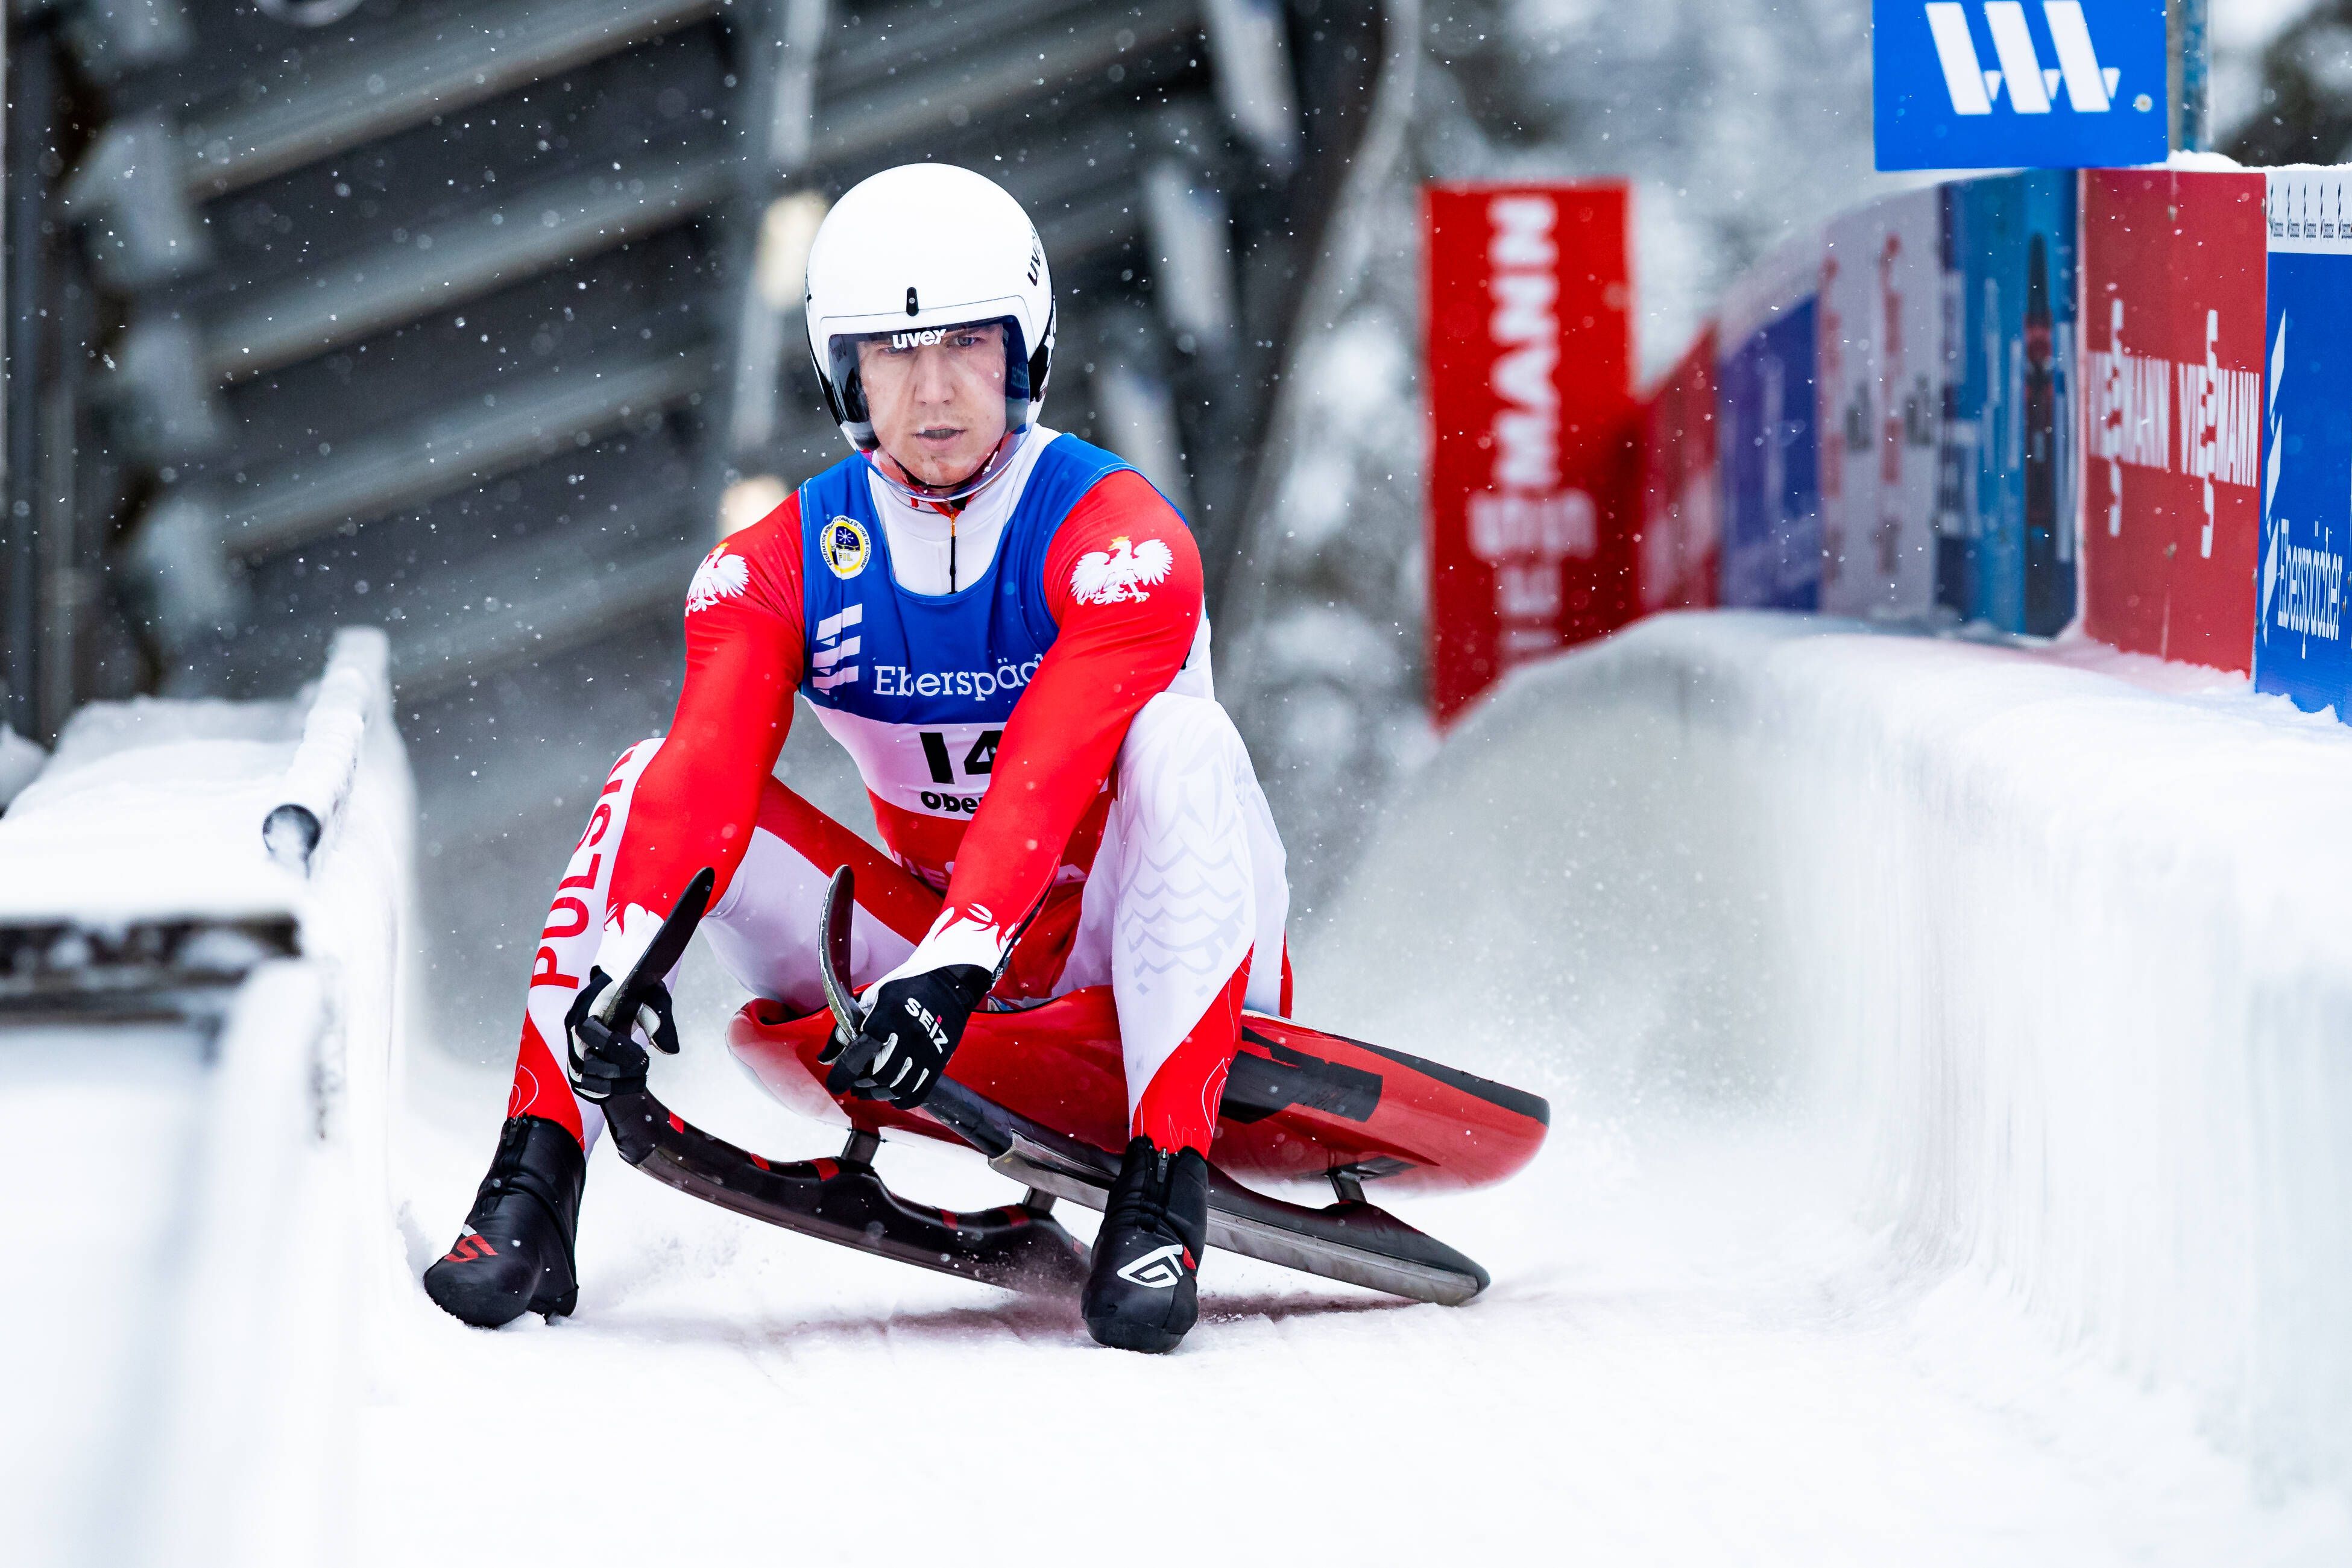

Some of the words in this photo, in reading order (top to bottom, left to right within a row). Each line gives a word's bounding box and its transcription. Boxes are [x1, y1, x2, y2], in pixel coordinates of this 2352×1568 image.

[892, 329, 947, 349] uvex
[1468, 196, 1598, 655] IESSMANN
[2277, 518, 2343, 660] Eberspächer
[873, 653, 1044, 701] Eberspäc
[919, 730, 1003, 784] 14
[921, 791, 983, 814] Obe
